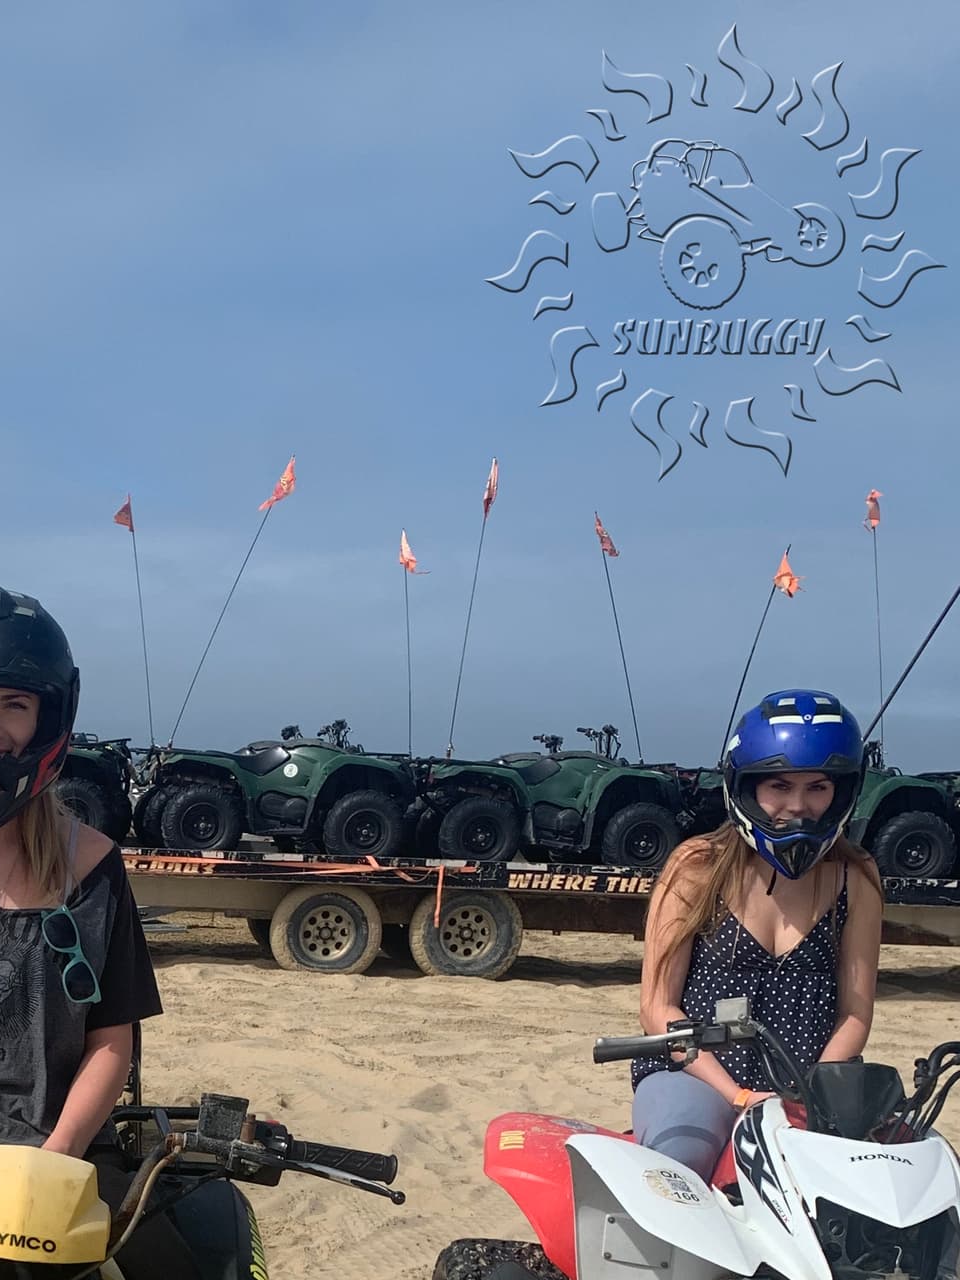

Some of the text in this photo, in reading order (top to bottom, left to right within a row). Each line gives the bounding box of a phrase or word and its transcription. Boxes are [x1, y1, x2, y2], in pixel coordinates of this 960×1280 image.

[508, 873, 653, 894] WHERE THE
[850, 1153, 914, 1166] HONDA
